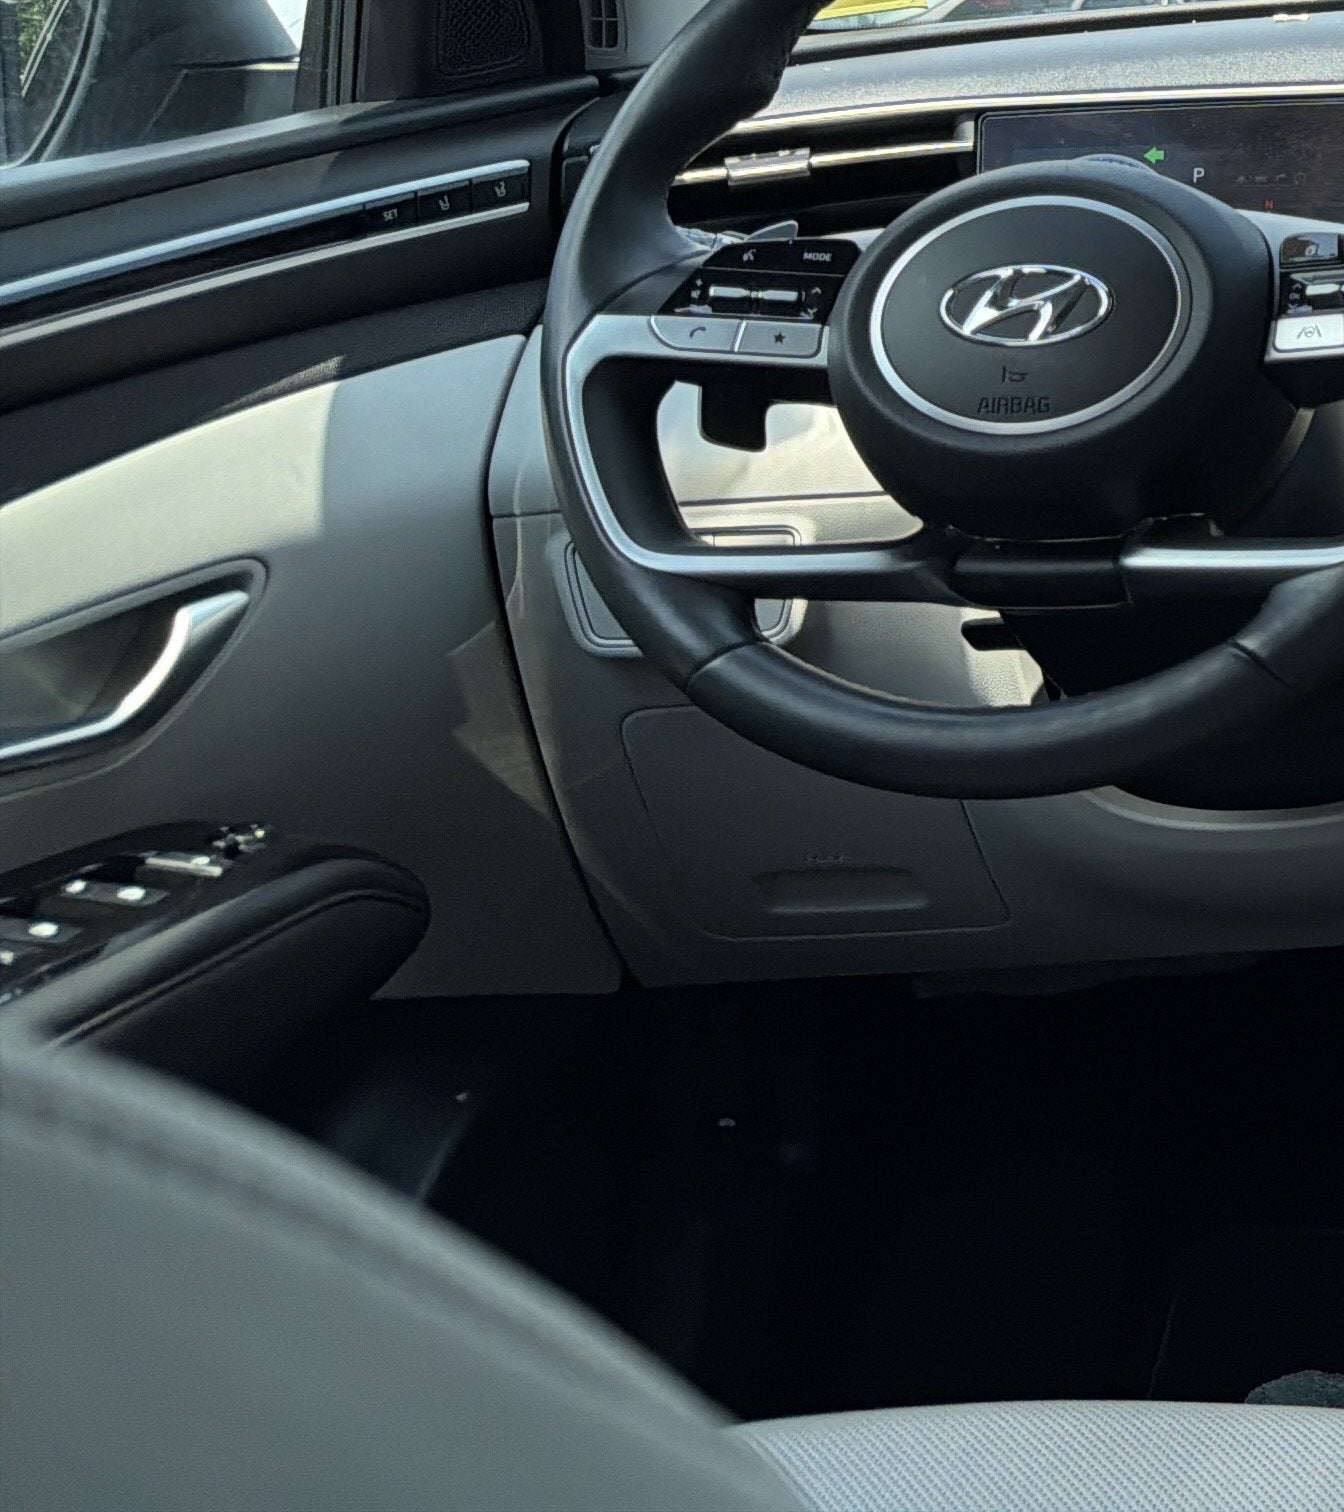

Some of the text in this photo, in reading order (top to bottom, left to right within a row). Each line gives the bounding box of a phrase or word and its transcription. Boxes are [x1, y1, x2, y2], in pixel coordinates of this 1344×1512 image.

[1192, 167, 1206, 184] P
[383, 207, 399, 222] SET
[802, 251, 833, 262] MODE
[977, 396, 1051, 415] AIRBAG
